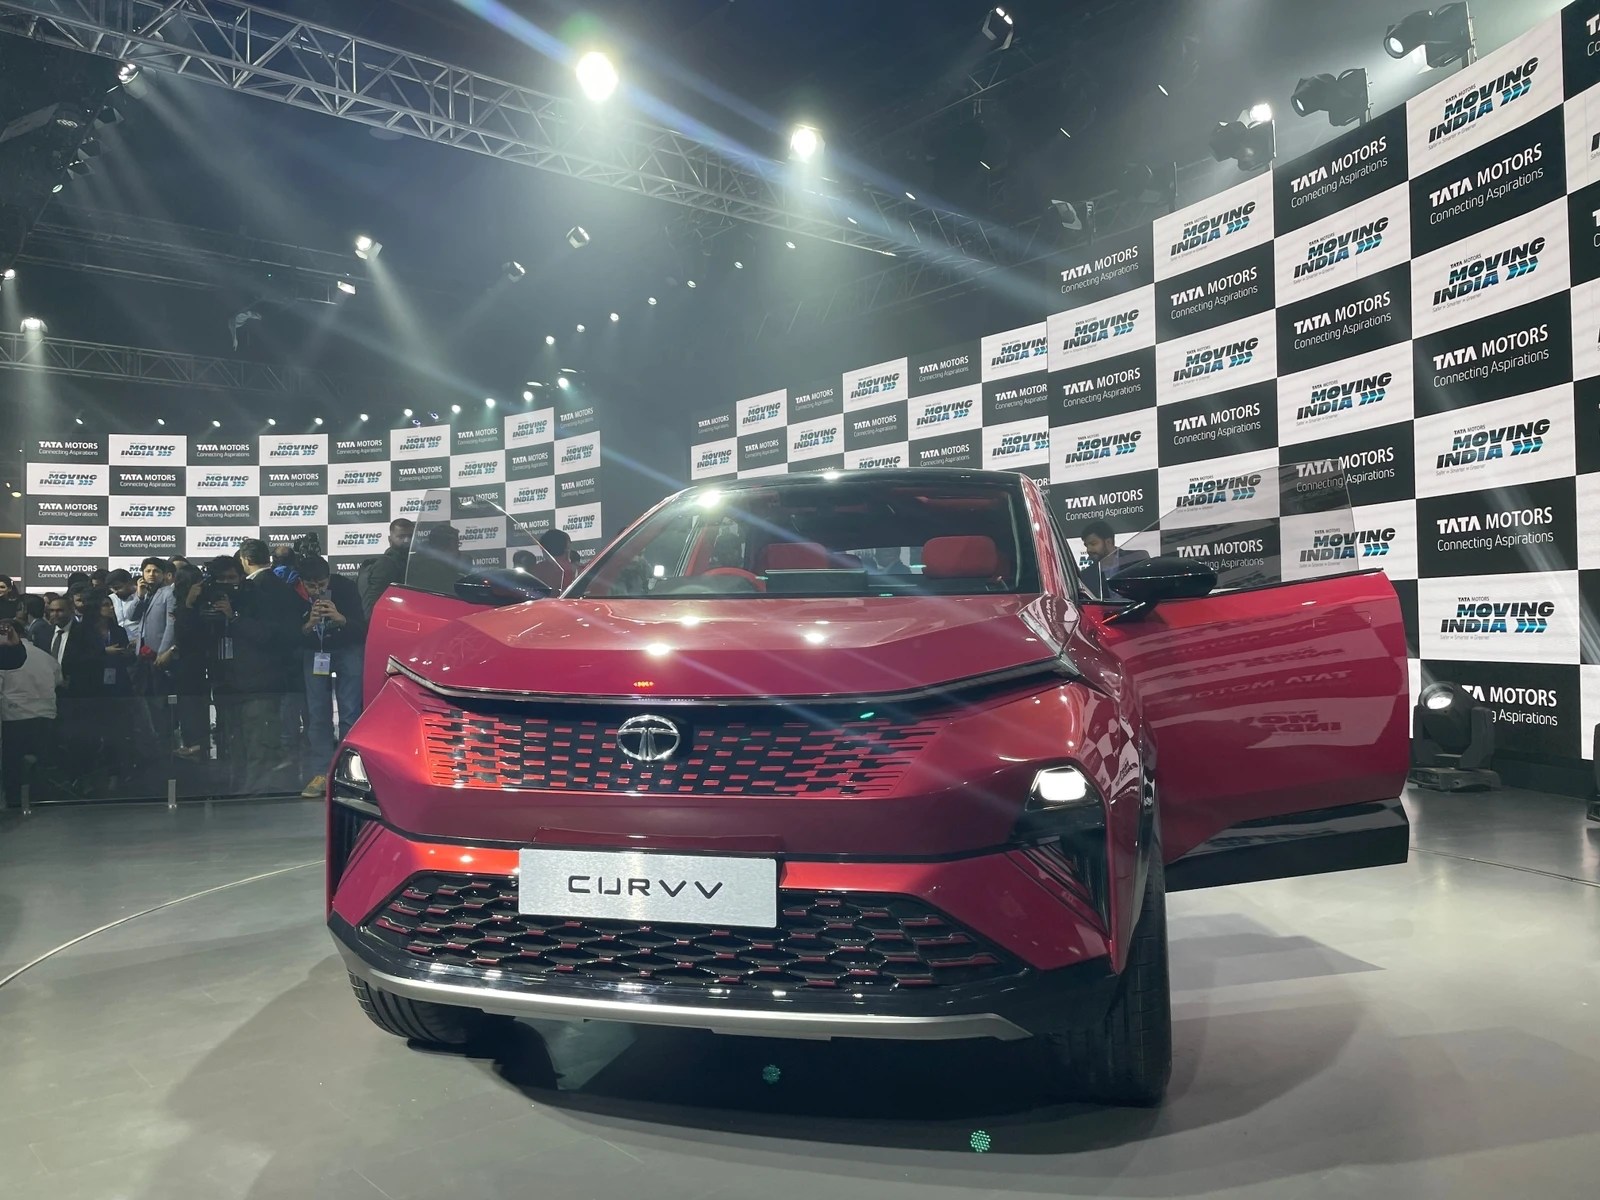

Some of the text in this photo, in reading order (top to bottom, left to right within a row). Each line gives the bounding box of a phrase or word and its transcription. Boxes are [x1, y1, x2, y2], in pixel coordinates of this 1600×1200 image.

[1444, 56, 1540, 121] MOVING
[1429, 97, 1494, 144] INDIA
[1291, 136, 1386, 193] TATA MOTORS
[1429, 142, 1542, 208] TATA MOTORS
[1291, 158, 1387, 208] Connecting Aspirations
[1430, 168, 1543, 225] Connecting Aspirations
[1183, 202, 1255, 240] MOVING
[1171, 228, 1221, 257] INDIA
[1308, 218, 1389, 260] MOVING
[1062, 246, 1138, 282] TATA MOTORS
[1294, 247, 1350, 279] INDIA
[1449, 237, 1545, 286] MOVING
[1062, 263, 1139, 294] Connecting Aspirations
[1171, 267, 1257, 306] TATA MOTORS
[1433, 270, 1499, 306] INDIA
[1172, 286, 1257, 319] Connecting Aspirations
[1075, 310, 1139, 337] MOVING
[1294, 292, 1390, 335] TATA MOTORS
[1064, 329, 1109, 350] INDIA
[1294, 313, 1391, 350] Connecting Aspirations
[1001, 336, 1047, 356] MOVIN
[1186, 338, 1258, 367] MOVING
[1433, 324, 1548, 371] TATA MOTORS
[919, 356, 968, 374] TATA MOTORS
[991, 353, 1030, 367] INDIA
[1174, 359, 1224, 382] INDIA
[1434, 349, 1549, 388] Connecting Aspirations
[857, 373, 899, 389] MOVING
[919, 367, 969, 382] Connecting Aspirations
[1063, 368, 1140, 396] TATA MOTORS
[795, 389, 833, 404] TATA MOTORS
[850, 386, 880, 398] INDIA
[995, 383, 1048, 402] TATA MOTOR
[1064, 385, 1141, 408] Connecting Aspirations
[1311, 373, 1392, 404] MOVING
[742, 413, 766, 424] INDIA
[748, 403, 781, 416] MOVING
[924, 400, 973, 416] MOVING
[1174, 403, 1259, 432] TATA MOTORS
[1297, 396, 1353, 420] INDIA
[518, 420, 548, 431] MOVING
[698, 415, 729, 427] TATA MOTORS
[854, 415, 896, 430] TATA MOTORS
[916, 413, 950, 426] INDIA
[458, 428, 498, 439] TATA MOTORS
[512, 429, 534, 437] INDIA
[800, 428, 837, 441] MOVING
[1077, 431, 1142, 452] MOVING
[1174, 422, 1260, 445] Connecting Aspirations
[1452, 419, 1551, 451] MOVING
[745, 439, 779, 452] TATA MOTORS
[793, 438, 820, 450] INDIA
[920, 444, 969, 459] TATA MOTORS
[992, 442, 1030, 457] INDIA
[464, 461, 498, 470] MOVING
[696, 459, 718, 468] INDIA
[702, 450, 732, 461] MOVING
[920, 455, 969, 467] Connecting Aspirations
[1066, 447, 1111, 464] INDIA
[1296, 447, 1394, 477] TATA MOTORS
[1436, 444, 1504, 469] INDIA
[1189, 474, 1261, 495] MOVING
[1296, 469, 1395, 492] Connecting Aspirations
[1066, 489, 1143, 509] TATA MOTORS
[1177, 491, 1227, 508] INDIA
[1066, 506, 1144, 521] Connecting Aspirations
[1437, 507, 1553, 535] TATA MOTORS
[1177, 539, 1263, 558] TATA MOTORS
[1313, 527, 1396, 549] MOVING
[1437, 532, 1554, 551] Connecting Aspirations
[1220, 556, 1264, 569] Aspirations
[1299, 546, 1356, 562] INDIA
[1457, 602, 1555, 618] MOVING
[1441, 619, 1508, 633] INDIA
[1490, 686, 1557, 707] MOTORS
[1498, 708, 1558, 726] Aspirations
[568, 875, 723, 899] CURVV
